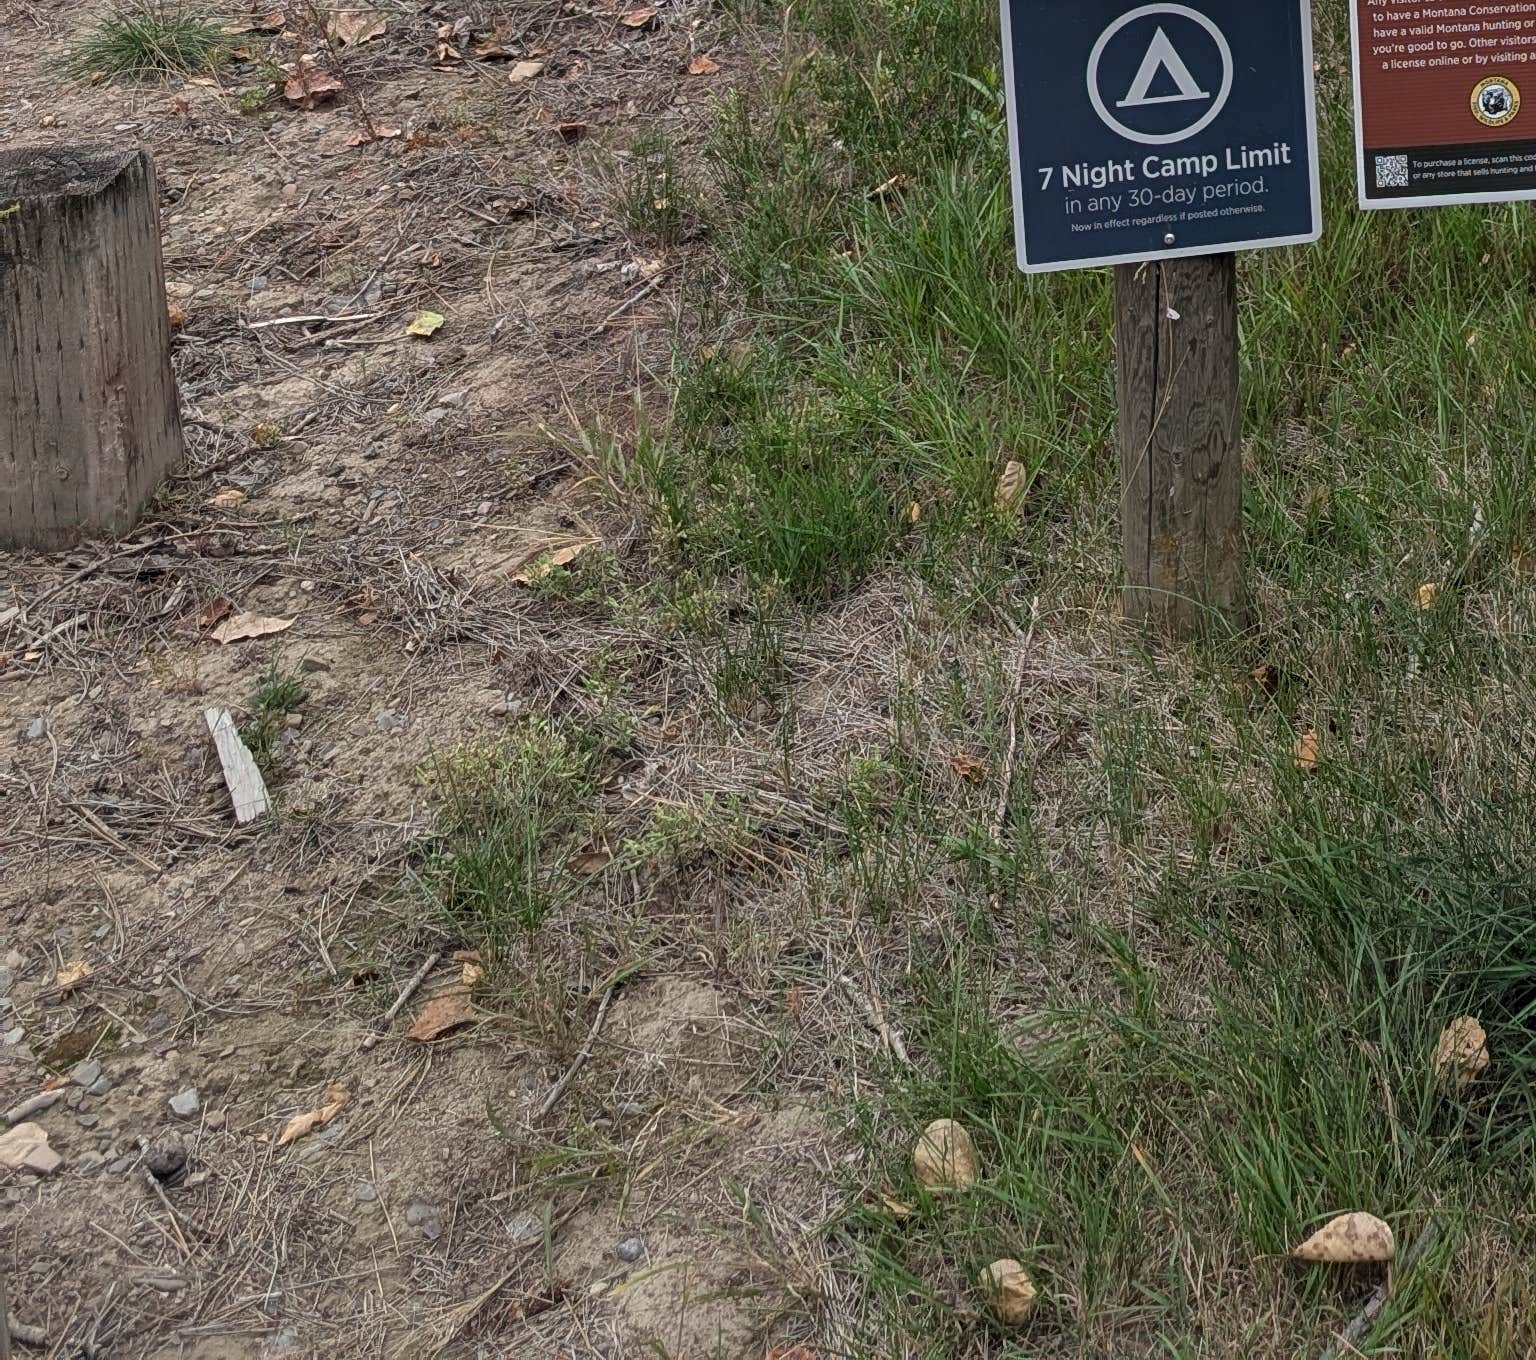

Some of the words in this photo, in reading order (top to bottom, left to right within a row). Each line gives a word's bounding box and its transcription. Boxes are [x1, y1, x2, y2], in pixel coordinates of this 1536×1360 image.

[1038, 168, 1053, 190] 7
[1062, 160, 1134, 188] Night
[1142, 152, 1217, 178] Camp
[1226, 143, 1291, 170] Limit
[1065, 197, 1081, 214] in
[1089, 194, 1122, 214] any
[1128, 186, 1197, 207] 30-day
[1203, 176, 1269, 202] period.
[1071, 223, 1092, 232] Now
[1093, 221, 1103, 230] in
[1103, 218, 1131, 229] effect
[1131, 213, 1178, 227] regardless
[1179, 211, 1186, 221] if
[1187, 207, 1219, 221] posted
[1219, 204, 1265, 216] otherwise.
